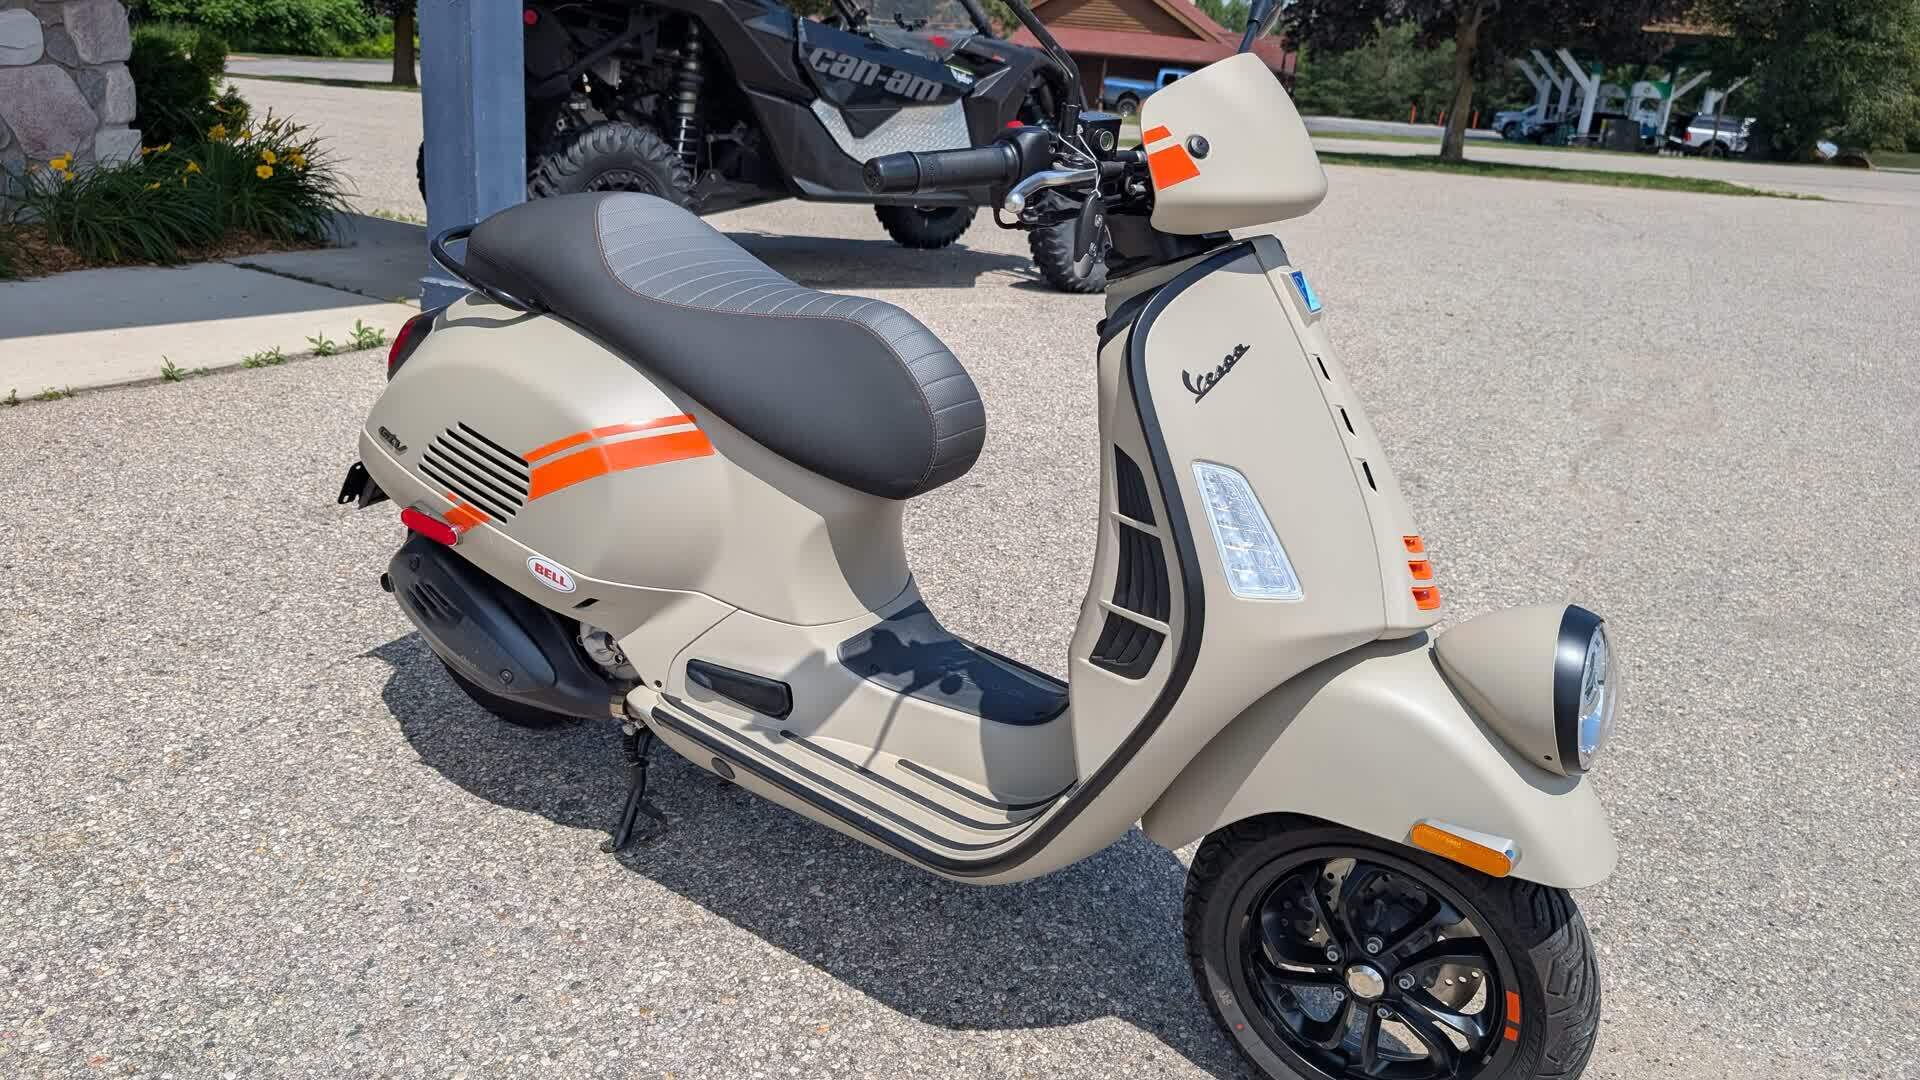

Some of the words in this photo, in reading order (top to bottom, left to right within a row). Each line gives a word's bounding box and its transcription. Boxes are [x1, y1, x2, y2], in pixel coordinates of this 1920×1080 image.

[809, 48, 943, 100] can-am
[1182, 343, 1251, 404] Vespa
[534, 562, 568, 588] BELL
